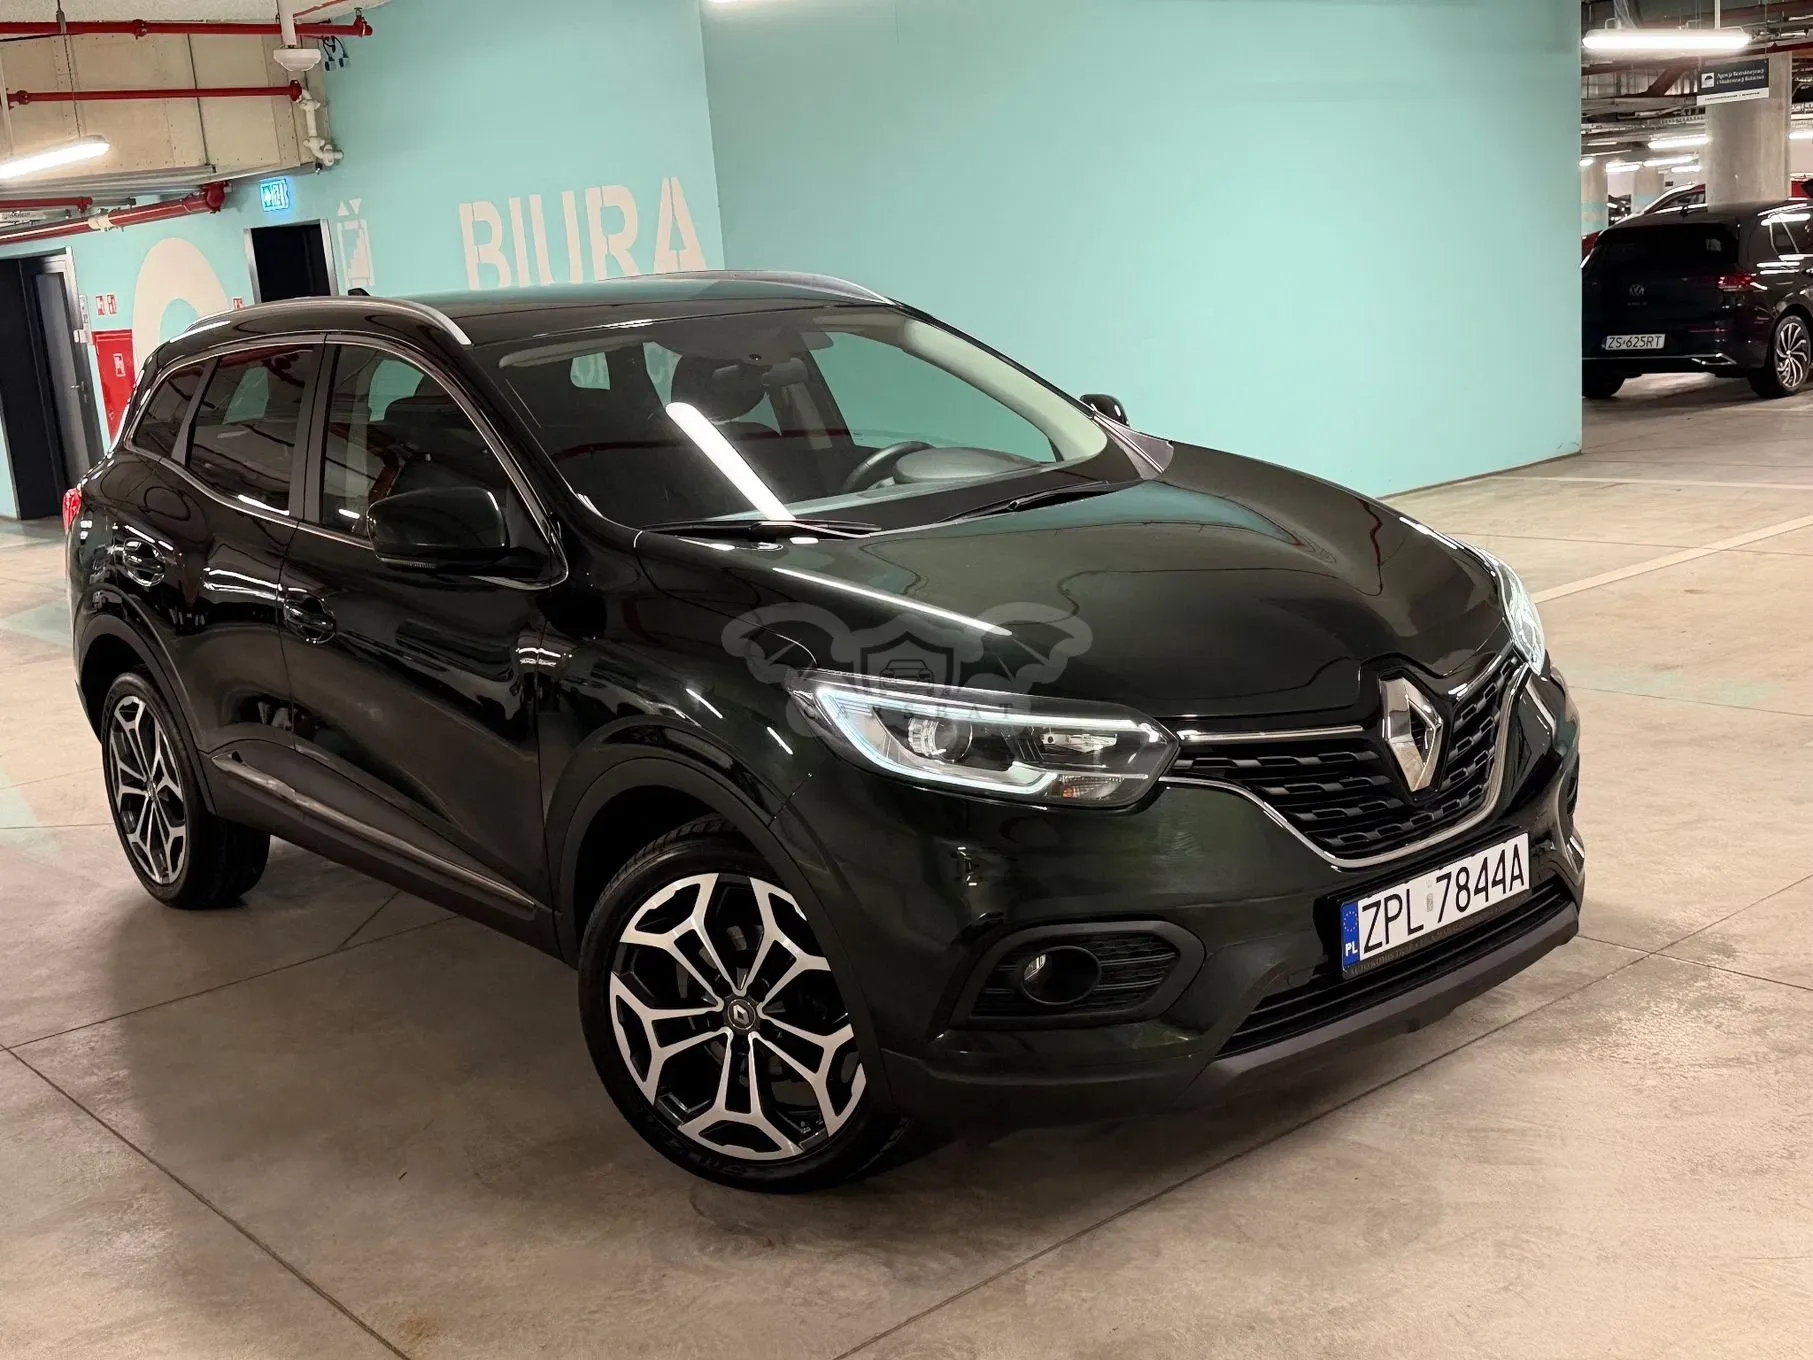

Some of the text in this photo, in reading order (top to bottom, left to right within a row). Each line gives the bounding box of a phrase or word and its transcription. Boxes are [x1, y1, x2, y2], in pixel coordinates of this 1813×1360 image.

[459, 177, 708, 290] BIURA
[1608, 336, 1622, 348] ZS
[1625, 335, 1661, 348] 625RT
[1362, 888, 1424, 954] ZPL
[1436, 843, 1525, 923] 7844A
[1345, 941, 1358, 957] PL
